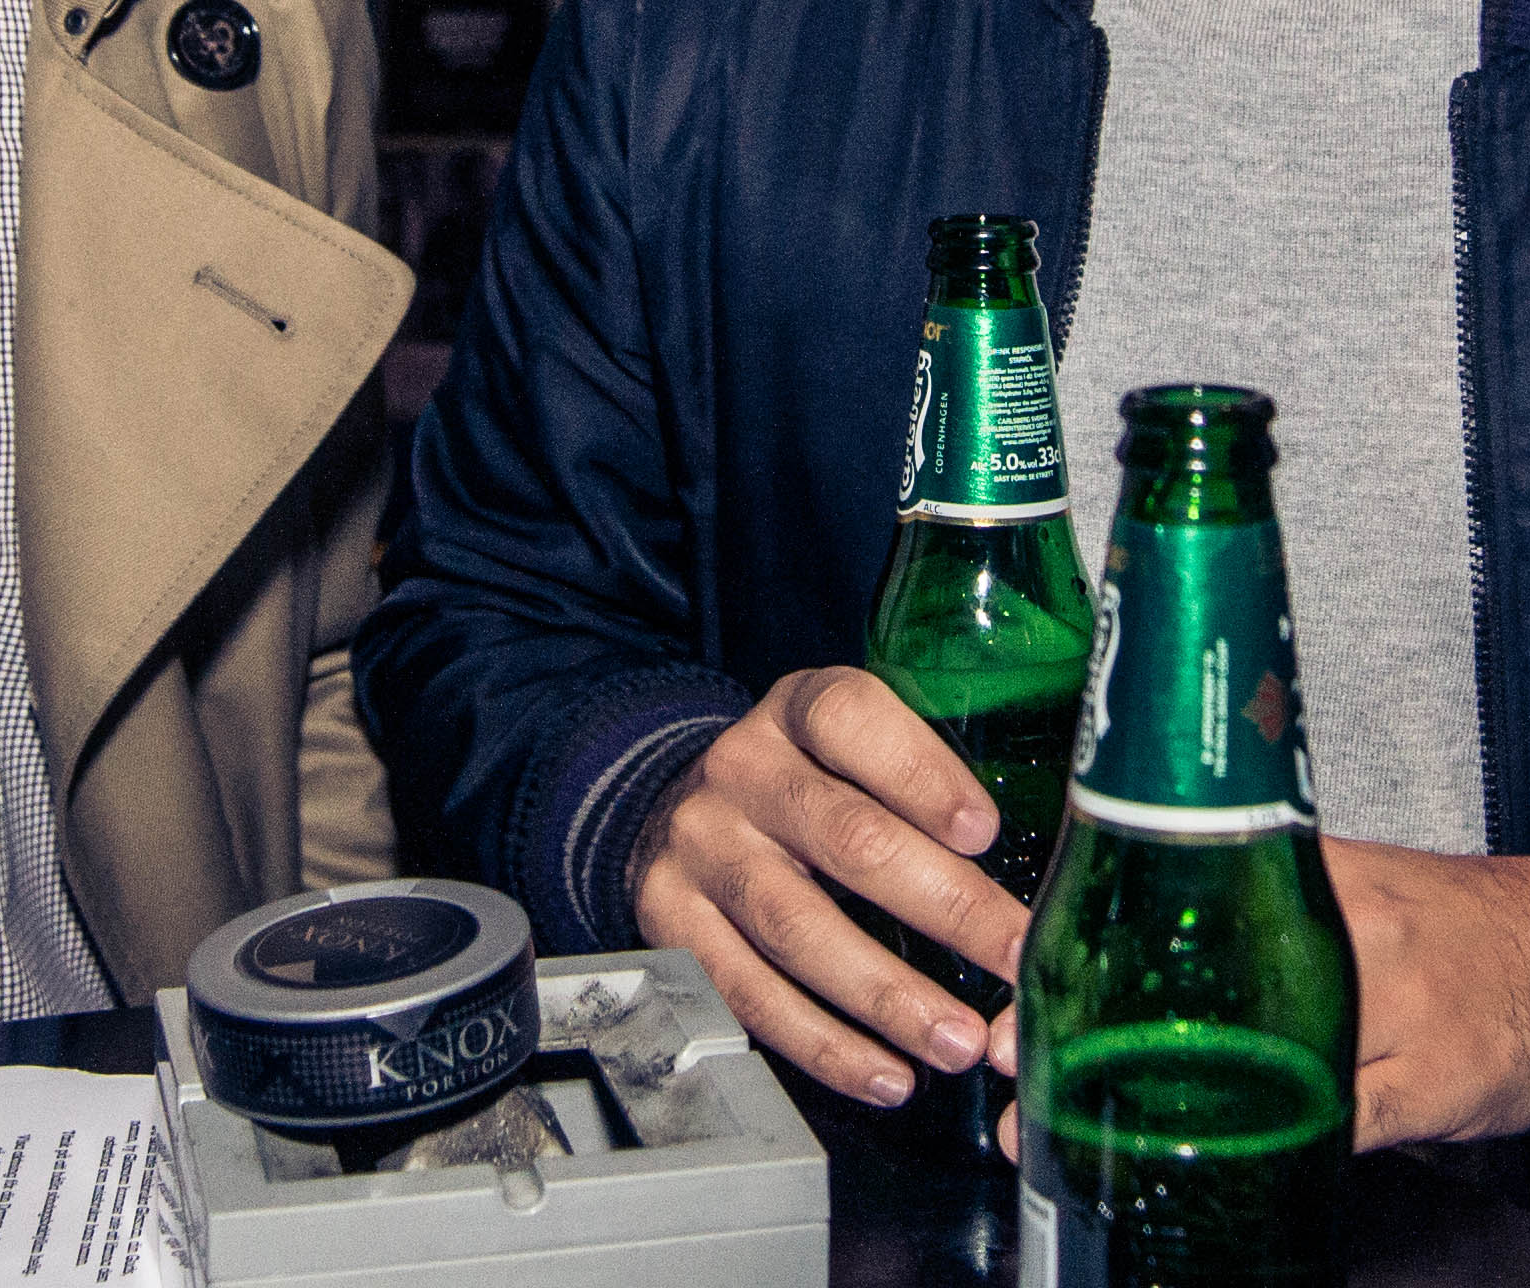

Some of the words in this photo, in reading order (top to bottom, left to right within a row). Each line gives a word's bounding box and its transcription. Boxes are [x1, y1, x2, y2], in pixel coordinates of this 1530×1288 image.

[898, 348, 932, 503] Carlsberg
[934, 391, 949, 474] COPENHAGEN
[365, 998, 519, 1089] KNOX
[405, 1047, 510, 1101] PORTION
